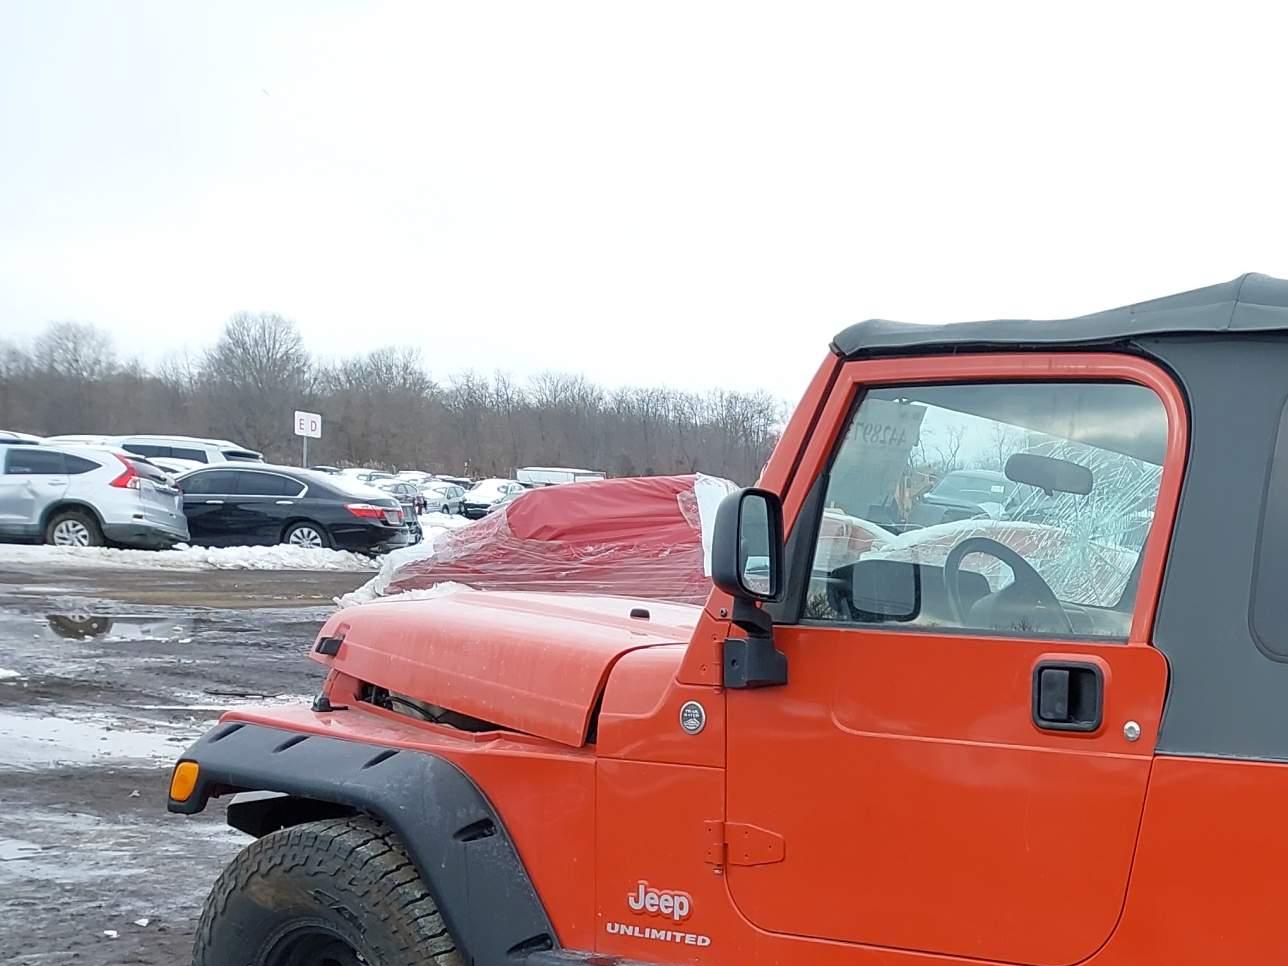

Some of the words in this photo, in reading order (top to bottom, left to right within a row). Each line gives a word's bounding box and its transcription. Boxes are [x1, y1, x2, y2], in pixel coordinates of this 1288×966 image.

[310, 420, 317, 432] D
[628, 883, 690, 921] Jeep
[606, 922, 712, 947] UNLIMITED
